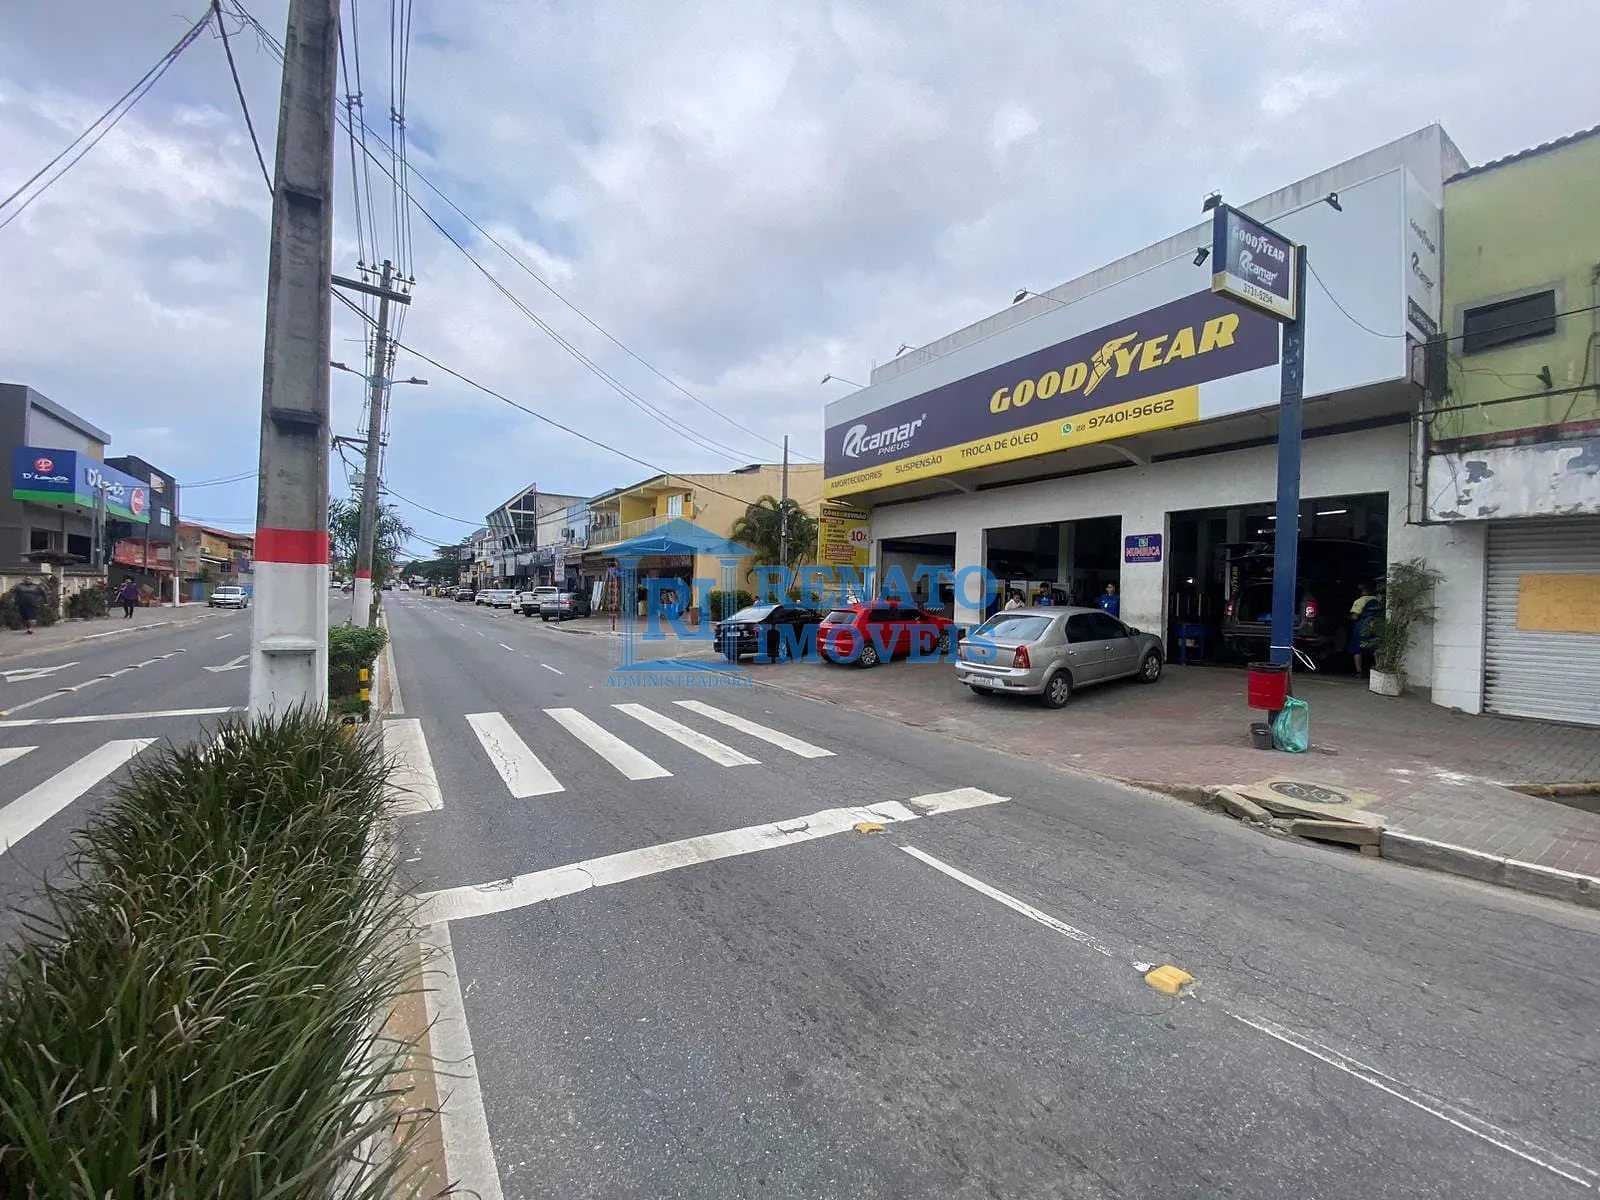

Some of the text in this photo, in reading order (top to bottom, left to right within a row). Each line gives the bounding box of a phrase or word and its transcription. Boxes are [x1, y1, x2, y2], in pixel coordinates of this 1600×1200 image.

[1088, 399, 1175, 430] 97401-9662
[877, 440, 911, 456] PNEUS
[960, 432, 1039, 459] TROCA DE ÓLEO
[895, 455, 943, 474] SUSPENSÃO
[831, 471, 883, 489] AMORTECEDORES
